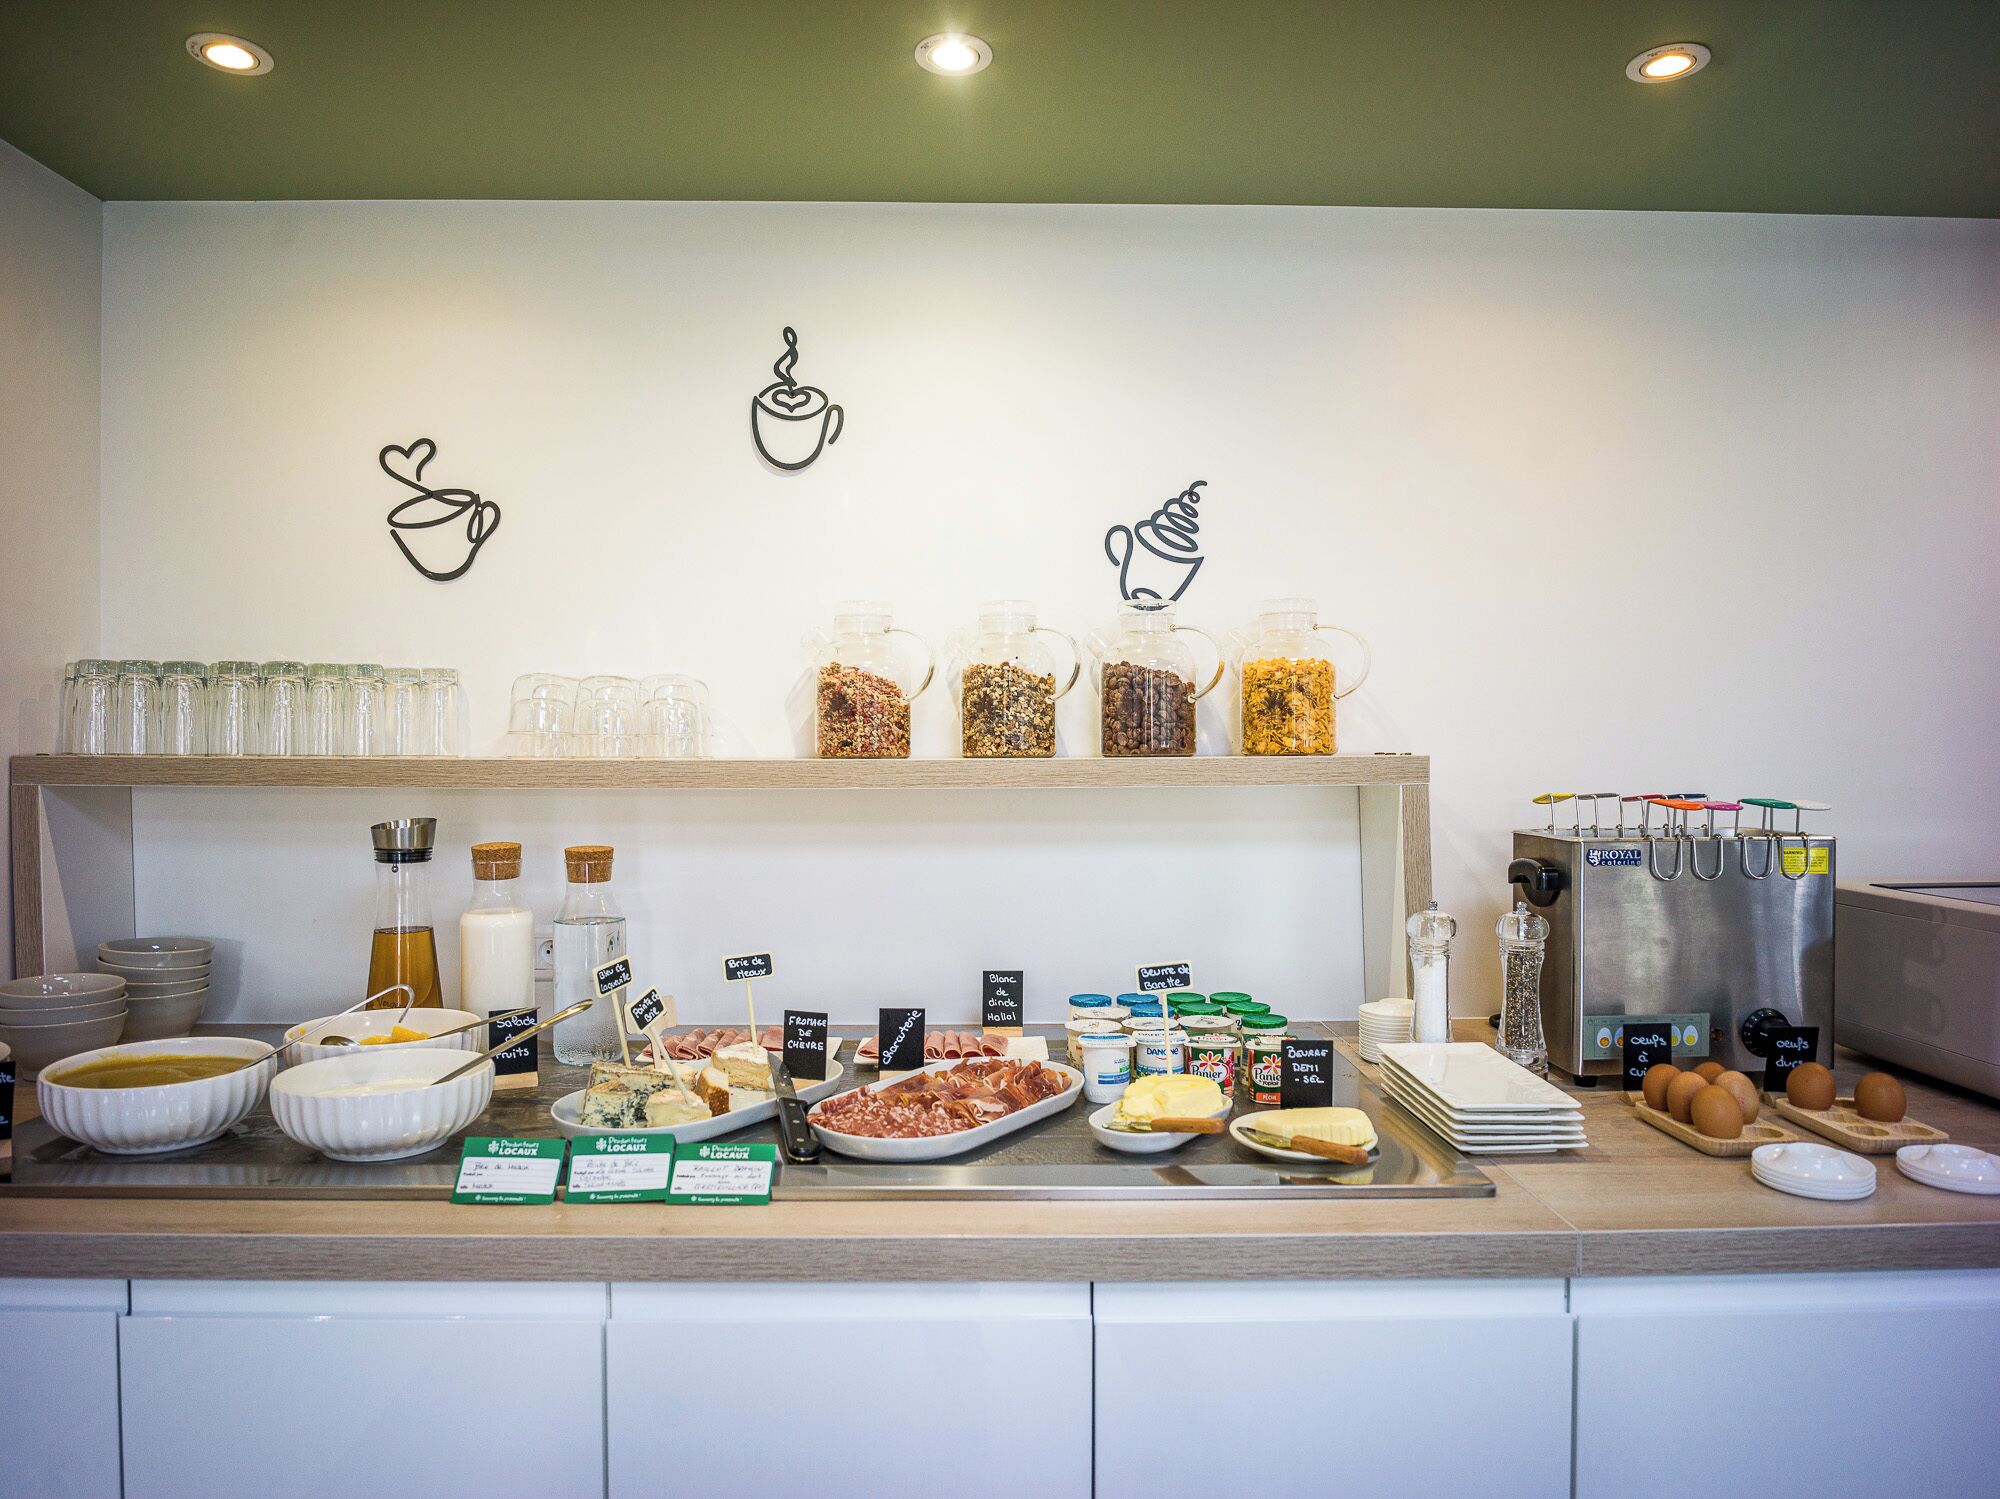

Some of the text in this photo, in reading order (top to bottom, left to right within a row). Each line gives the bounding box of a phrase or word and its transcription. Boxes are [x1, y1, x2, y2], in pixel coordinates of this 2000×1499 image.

[1602, 850, 1641, 859] ROYAL
[727, 956, 765, 968] Brie de
[1140, 965, 1191, 978] Beurre de
[988, 973, 1017, 983] Blanc
[996, 987, 1009, 996] de
[988, 998, 1018, 1007] dinde
[987, 1011, 1017, 1021] Hallal
[496, 1015, 538, 1028] Salade
[788, 1015, 827, 1028] FROMAGE
[798, 1028, 813, 1037] DE
[787, 1037, 824, 1051] CHÈVRE
[1286, 1045, 1328, 1059] BEURRE
[1191, 1064, 1223, 1078] Panier
[1292, 1062, 1319, 1072] DEMI
[1629, 1067, 1647, 1077] cui
[1254, 1067, 1281, 1081] Panie
[499, 1147, 538, 1155] LOCAUX
[607, 1144, 646, 1152] LOCAUX
